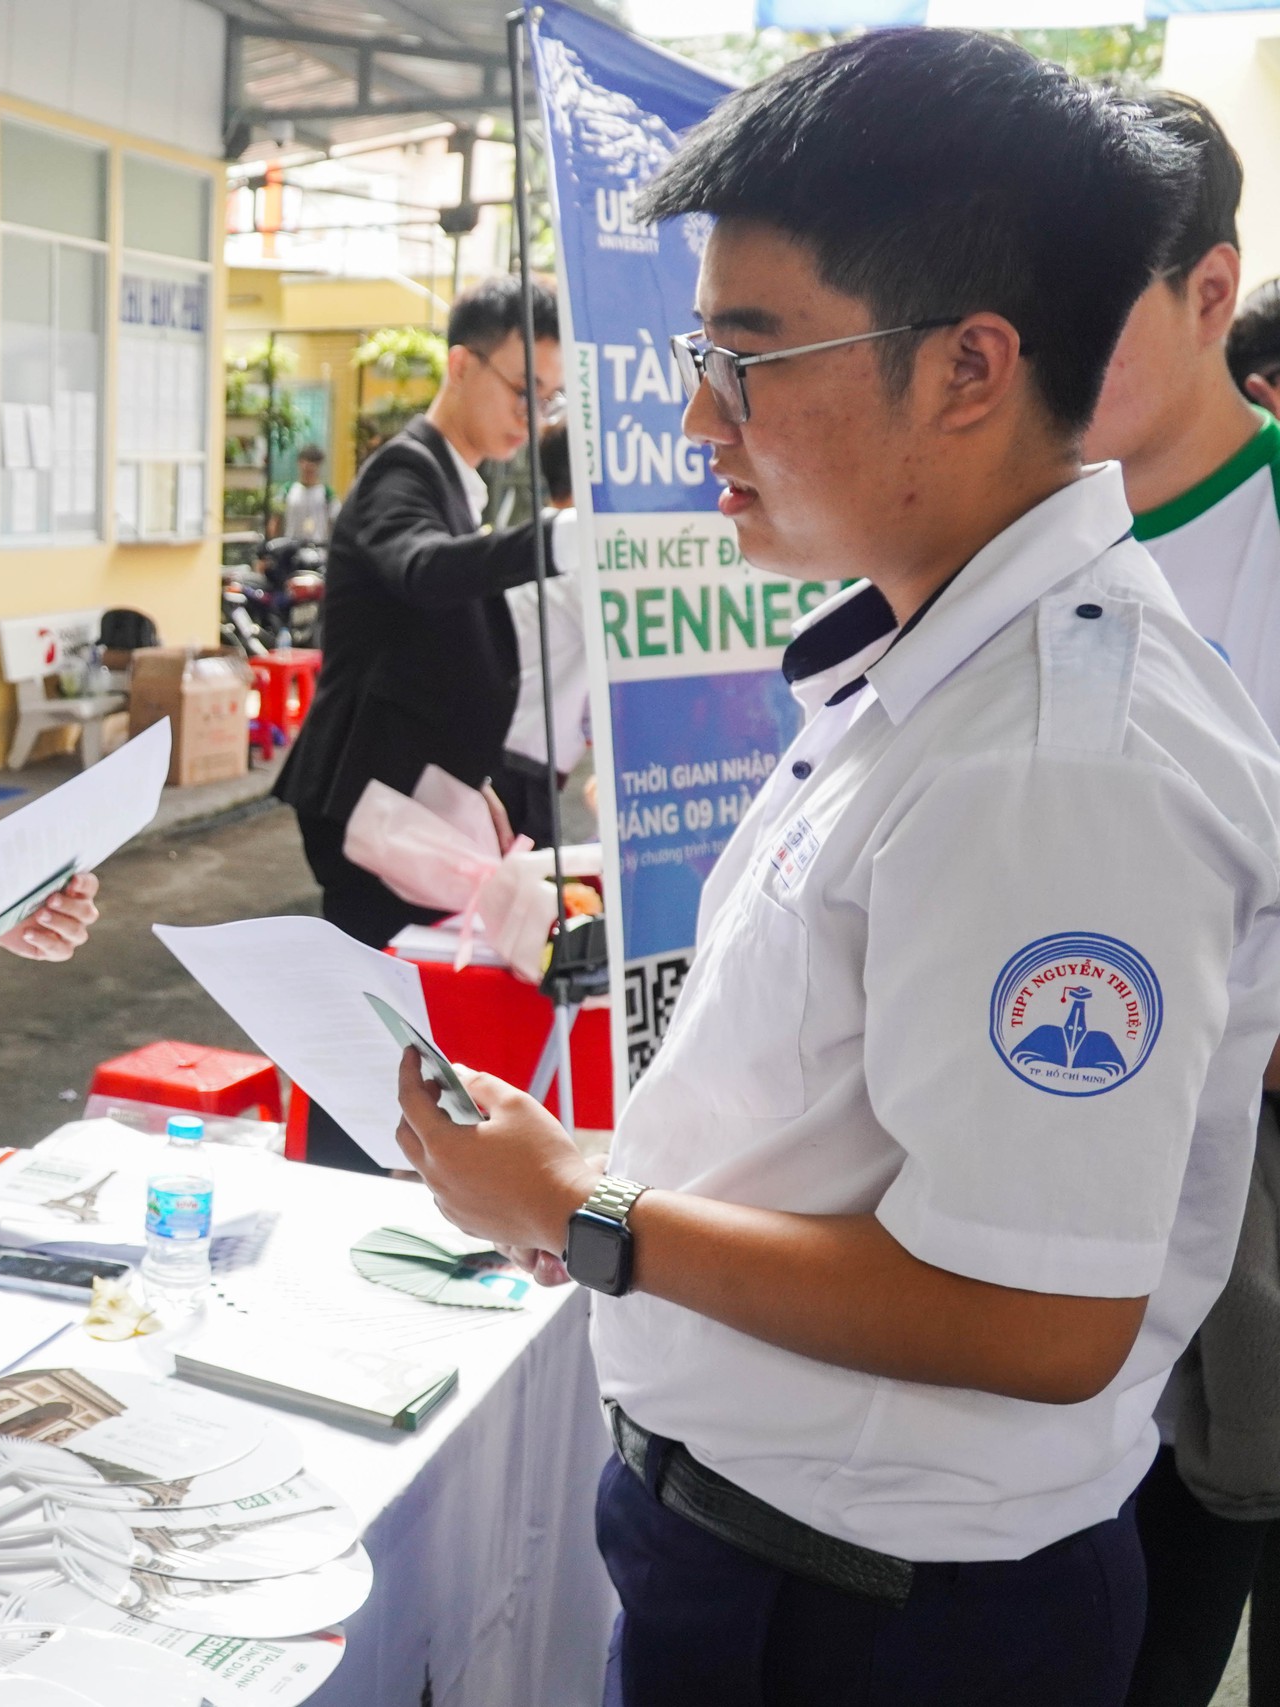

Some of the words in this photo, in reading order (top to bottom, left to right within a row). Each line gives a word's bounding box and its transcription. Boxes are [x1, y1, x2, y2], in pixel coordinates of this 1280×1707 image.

[605, 415, 705, 486] ỨNG
[596, 529, 648, 571] LIÊN
[657, 523, 710, 569] KẾT
[622, 760, 668, 796] THỜI
[671, 760, 719, 790] GIAN
[722, 748, 777, 786] NHẬP
[683, 797, 714, 831] 09
[1010, 986, 1034, 1029] THPT
[1031, 958, 1106, 989] NGUYỄN
[1106, 973, 1133, 1001] THỊ
[1124, 1000, 1142, 1041] DIỆU
[1081, 1073, 1107, 1085] MINH
